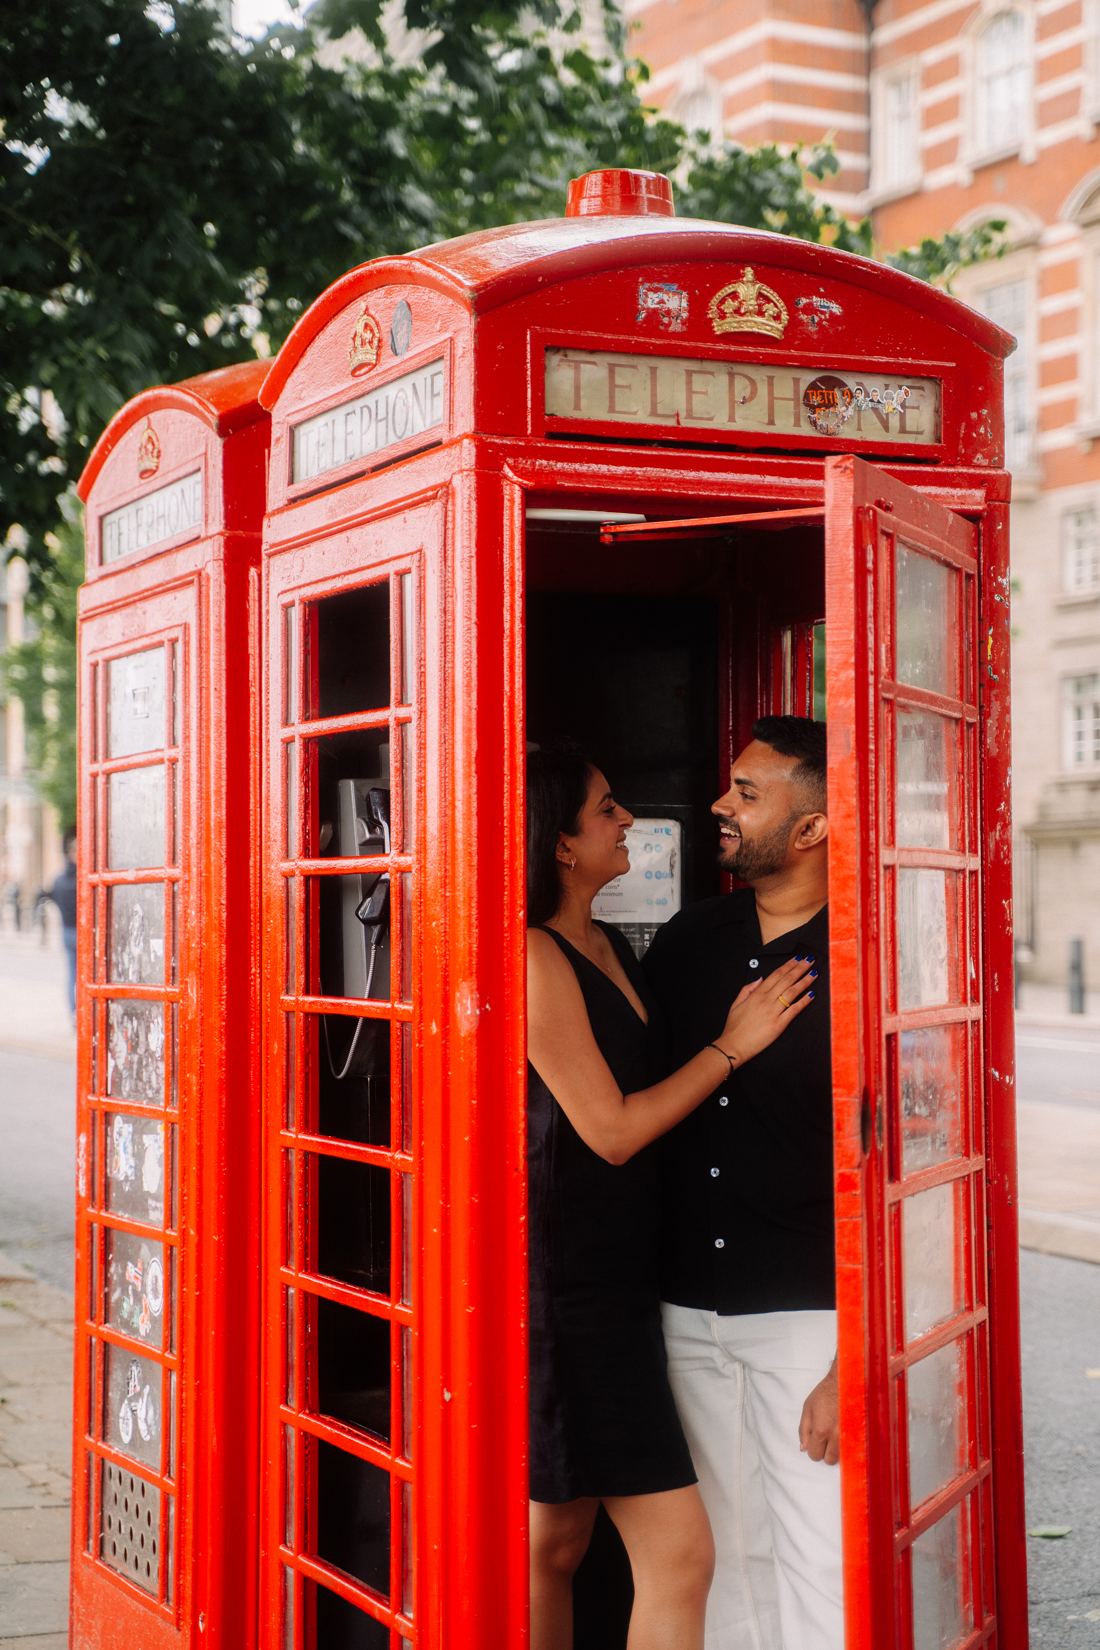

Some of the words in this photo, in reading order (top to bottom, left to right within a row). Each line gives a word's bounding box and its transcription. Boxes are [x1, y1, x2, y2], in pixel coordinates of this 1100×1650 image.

[300, 372, 443, 476] TELEPHONE
[559, 358, 926, 435] TELEPHNE
[108, 480, 201, 558] TELEPHONE
